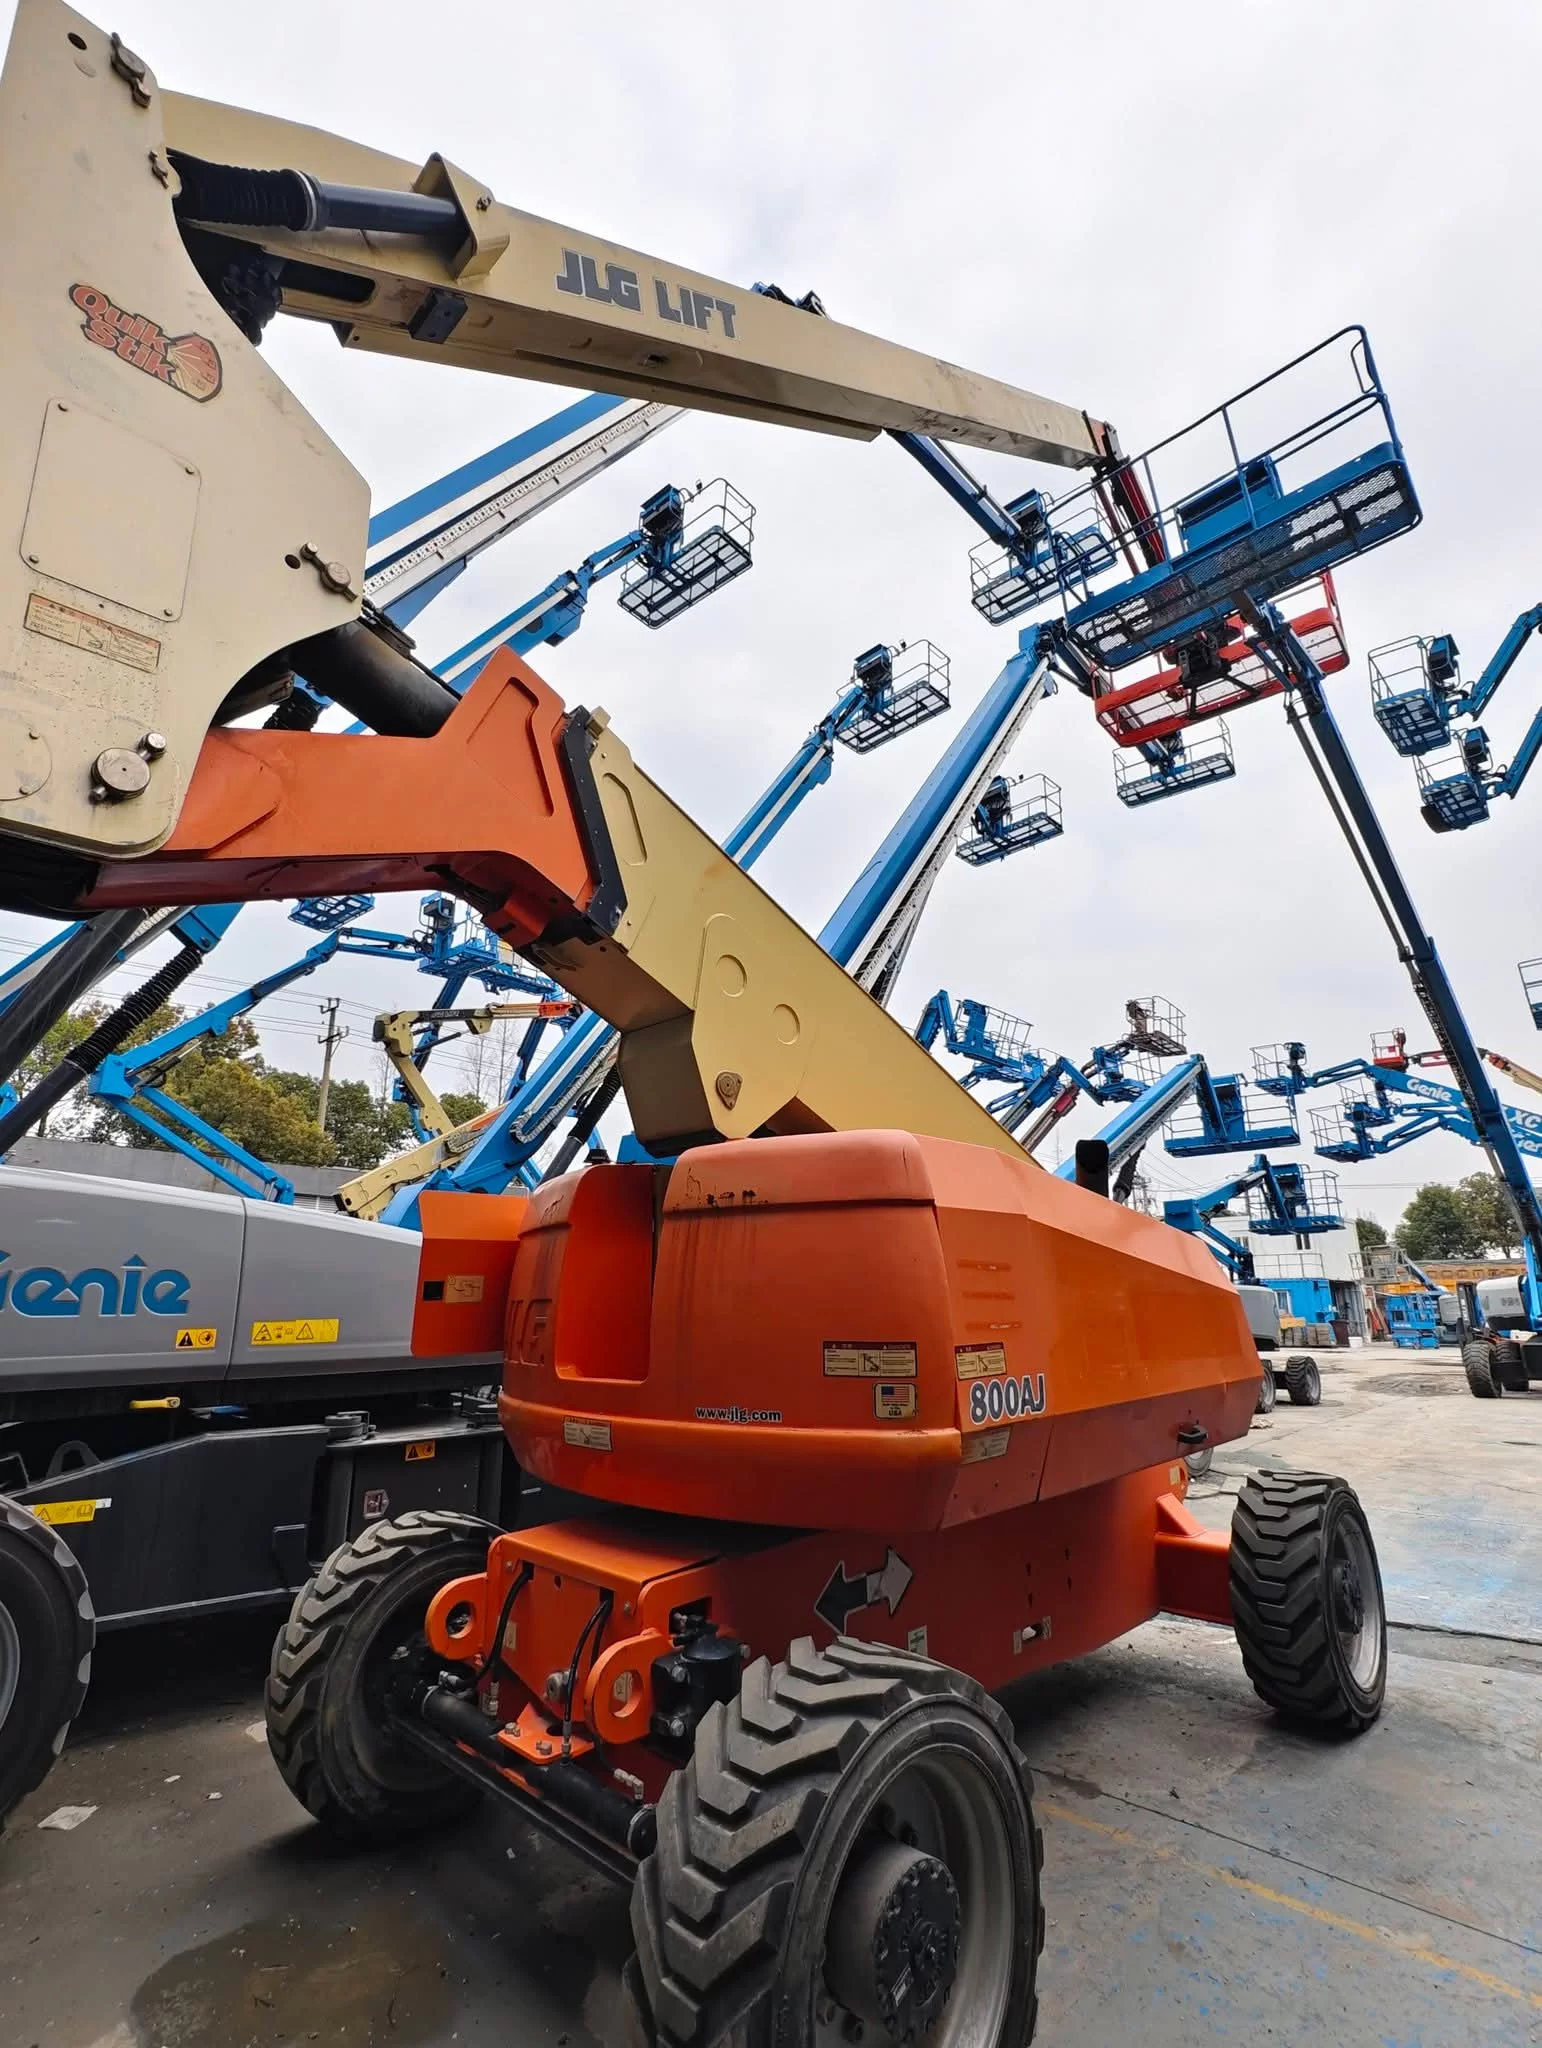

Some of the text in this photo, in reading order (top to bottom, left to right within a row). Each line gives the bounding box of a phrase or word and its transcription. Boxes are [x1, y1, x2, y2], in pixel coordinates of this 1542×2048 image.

[69, 283, 171, 356] Quik
[556, 248, 738, 340] JLG LIFT
[81, 319, 176, 383] Stik
[1406, 1078, 1452, 1101] Genie
[0, 1251, 191, 1318] enie
[695, 1407, 783, 1423] www.jlg.com
[970, 1373, 1046, 1426] 800AJ
